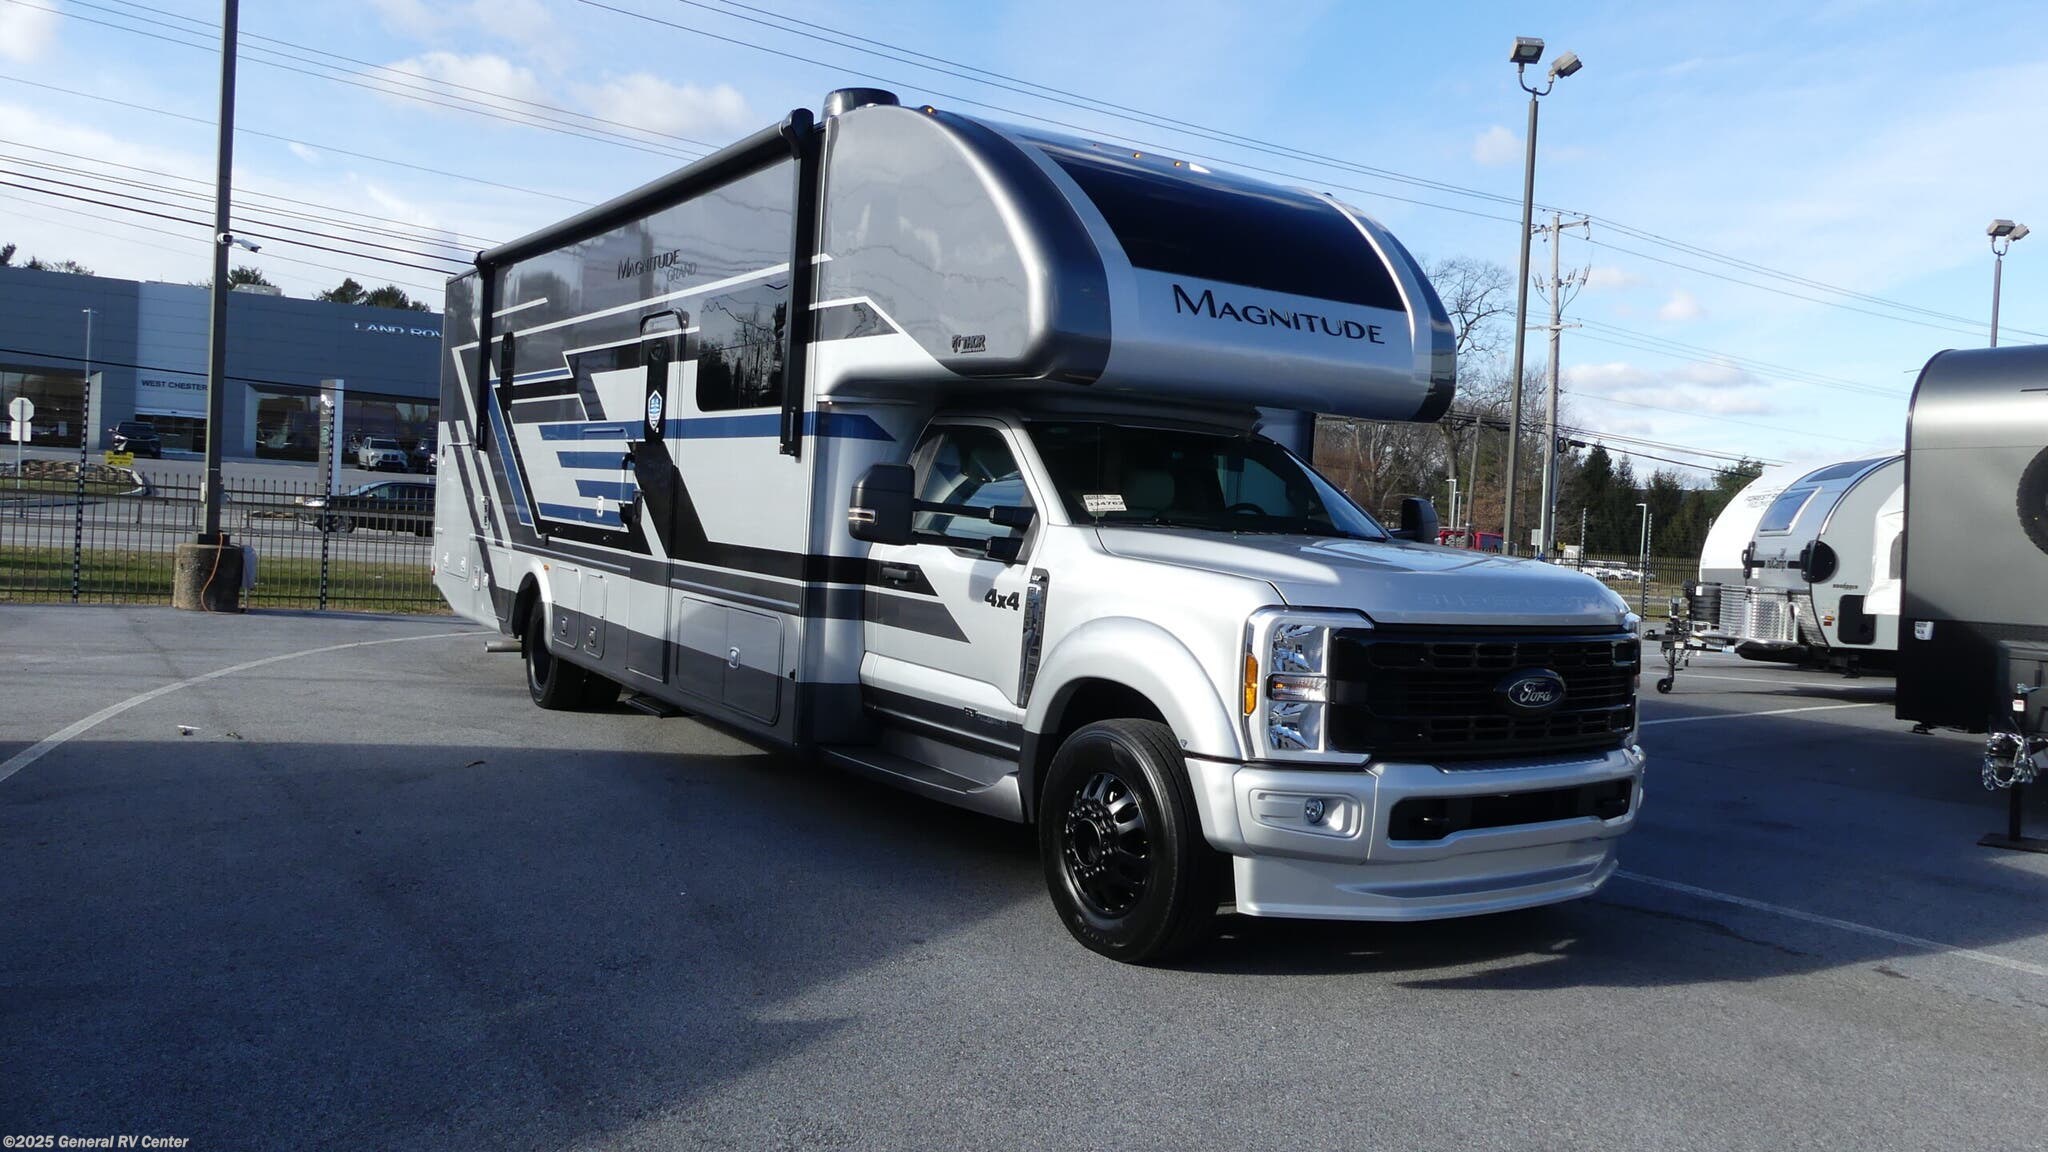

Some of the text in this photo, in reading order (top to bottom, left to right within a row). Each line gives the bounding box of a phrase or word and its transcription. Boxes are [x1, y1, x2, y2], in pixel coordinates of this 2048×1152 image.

[617, 248, 681, 280] MAGNITUDE
[666, 262, 698, 281] GRAND
[1172, 283, 1386, 344] MAGNITUDE
[354, 322, 405, 334] LAND
[142, 380, 208, 391] WEST CHESTER
[984, 588, 1020, 611] 4x4
[1519, 680, 1554, 703] Ford
